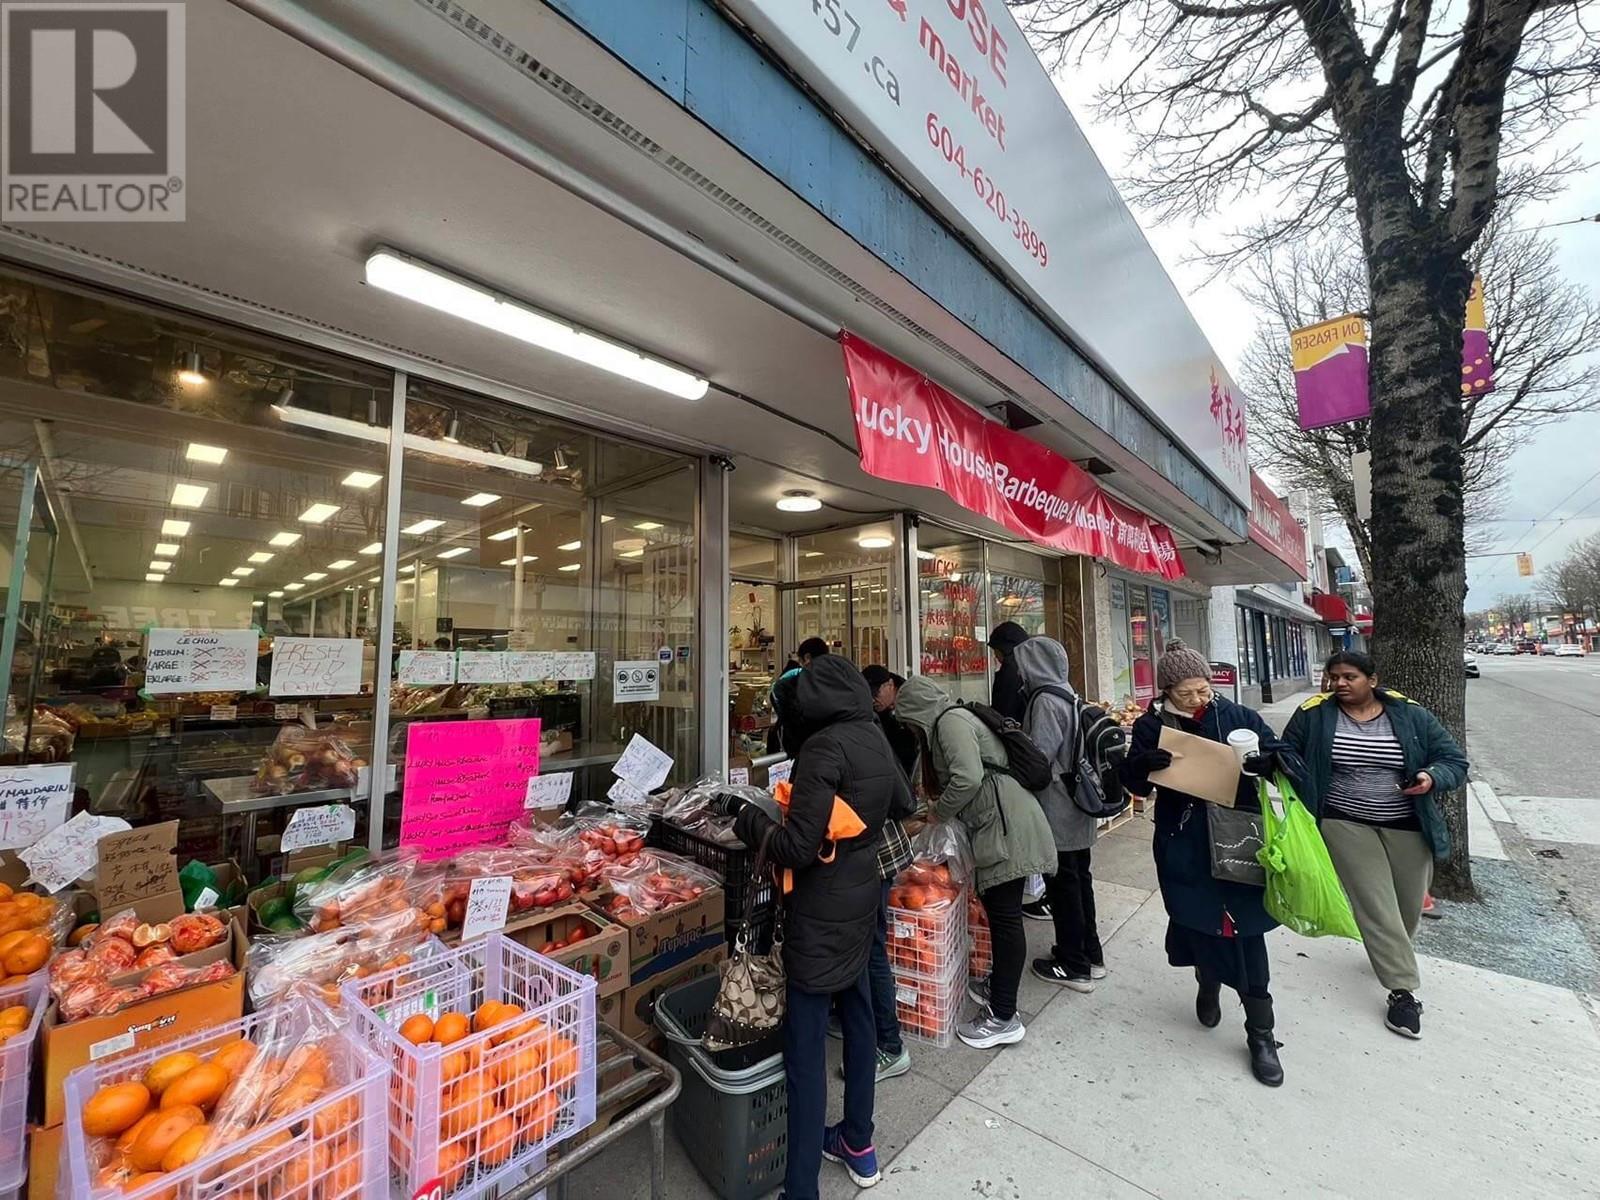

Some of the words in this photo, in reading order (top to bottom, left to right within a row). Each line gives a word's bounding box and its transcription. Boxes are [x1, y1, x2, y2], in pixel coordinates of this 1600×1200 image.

[919, 15, 1006, 152] market
[927, 112, 1048, 268] 604-620-3899
[855, 396, 932, 454] ucky
[921, 558, 959, 577] LUCKY
[275, 641, 344, 661] FRESH
[5, 783, 69, 798] MANDARIN
